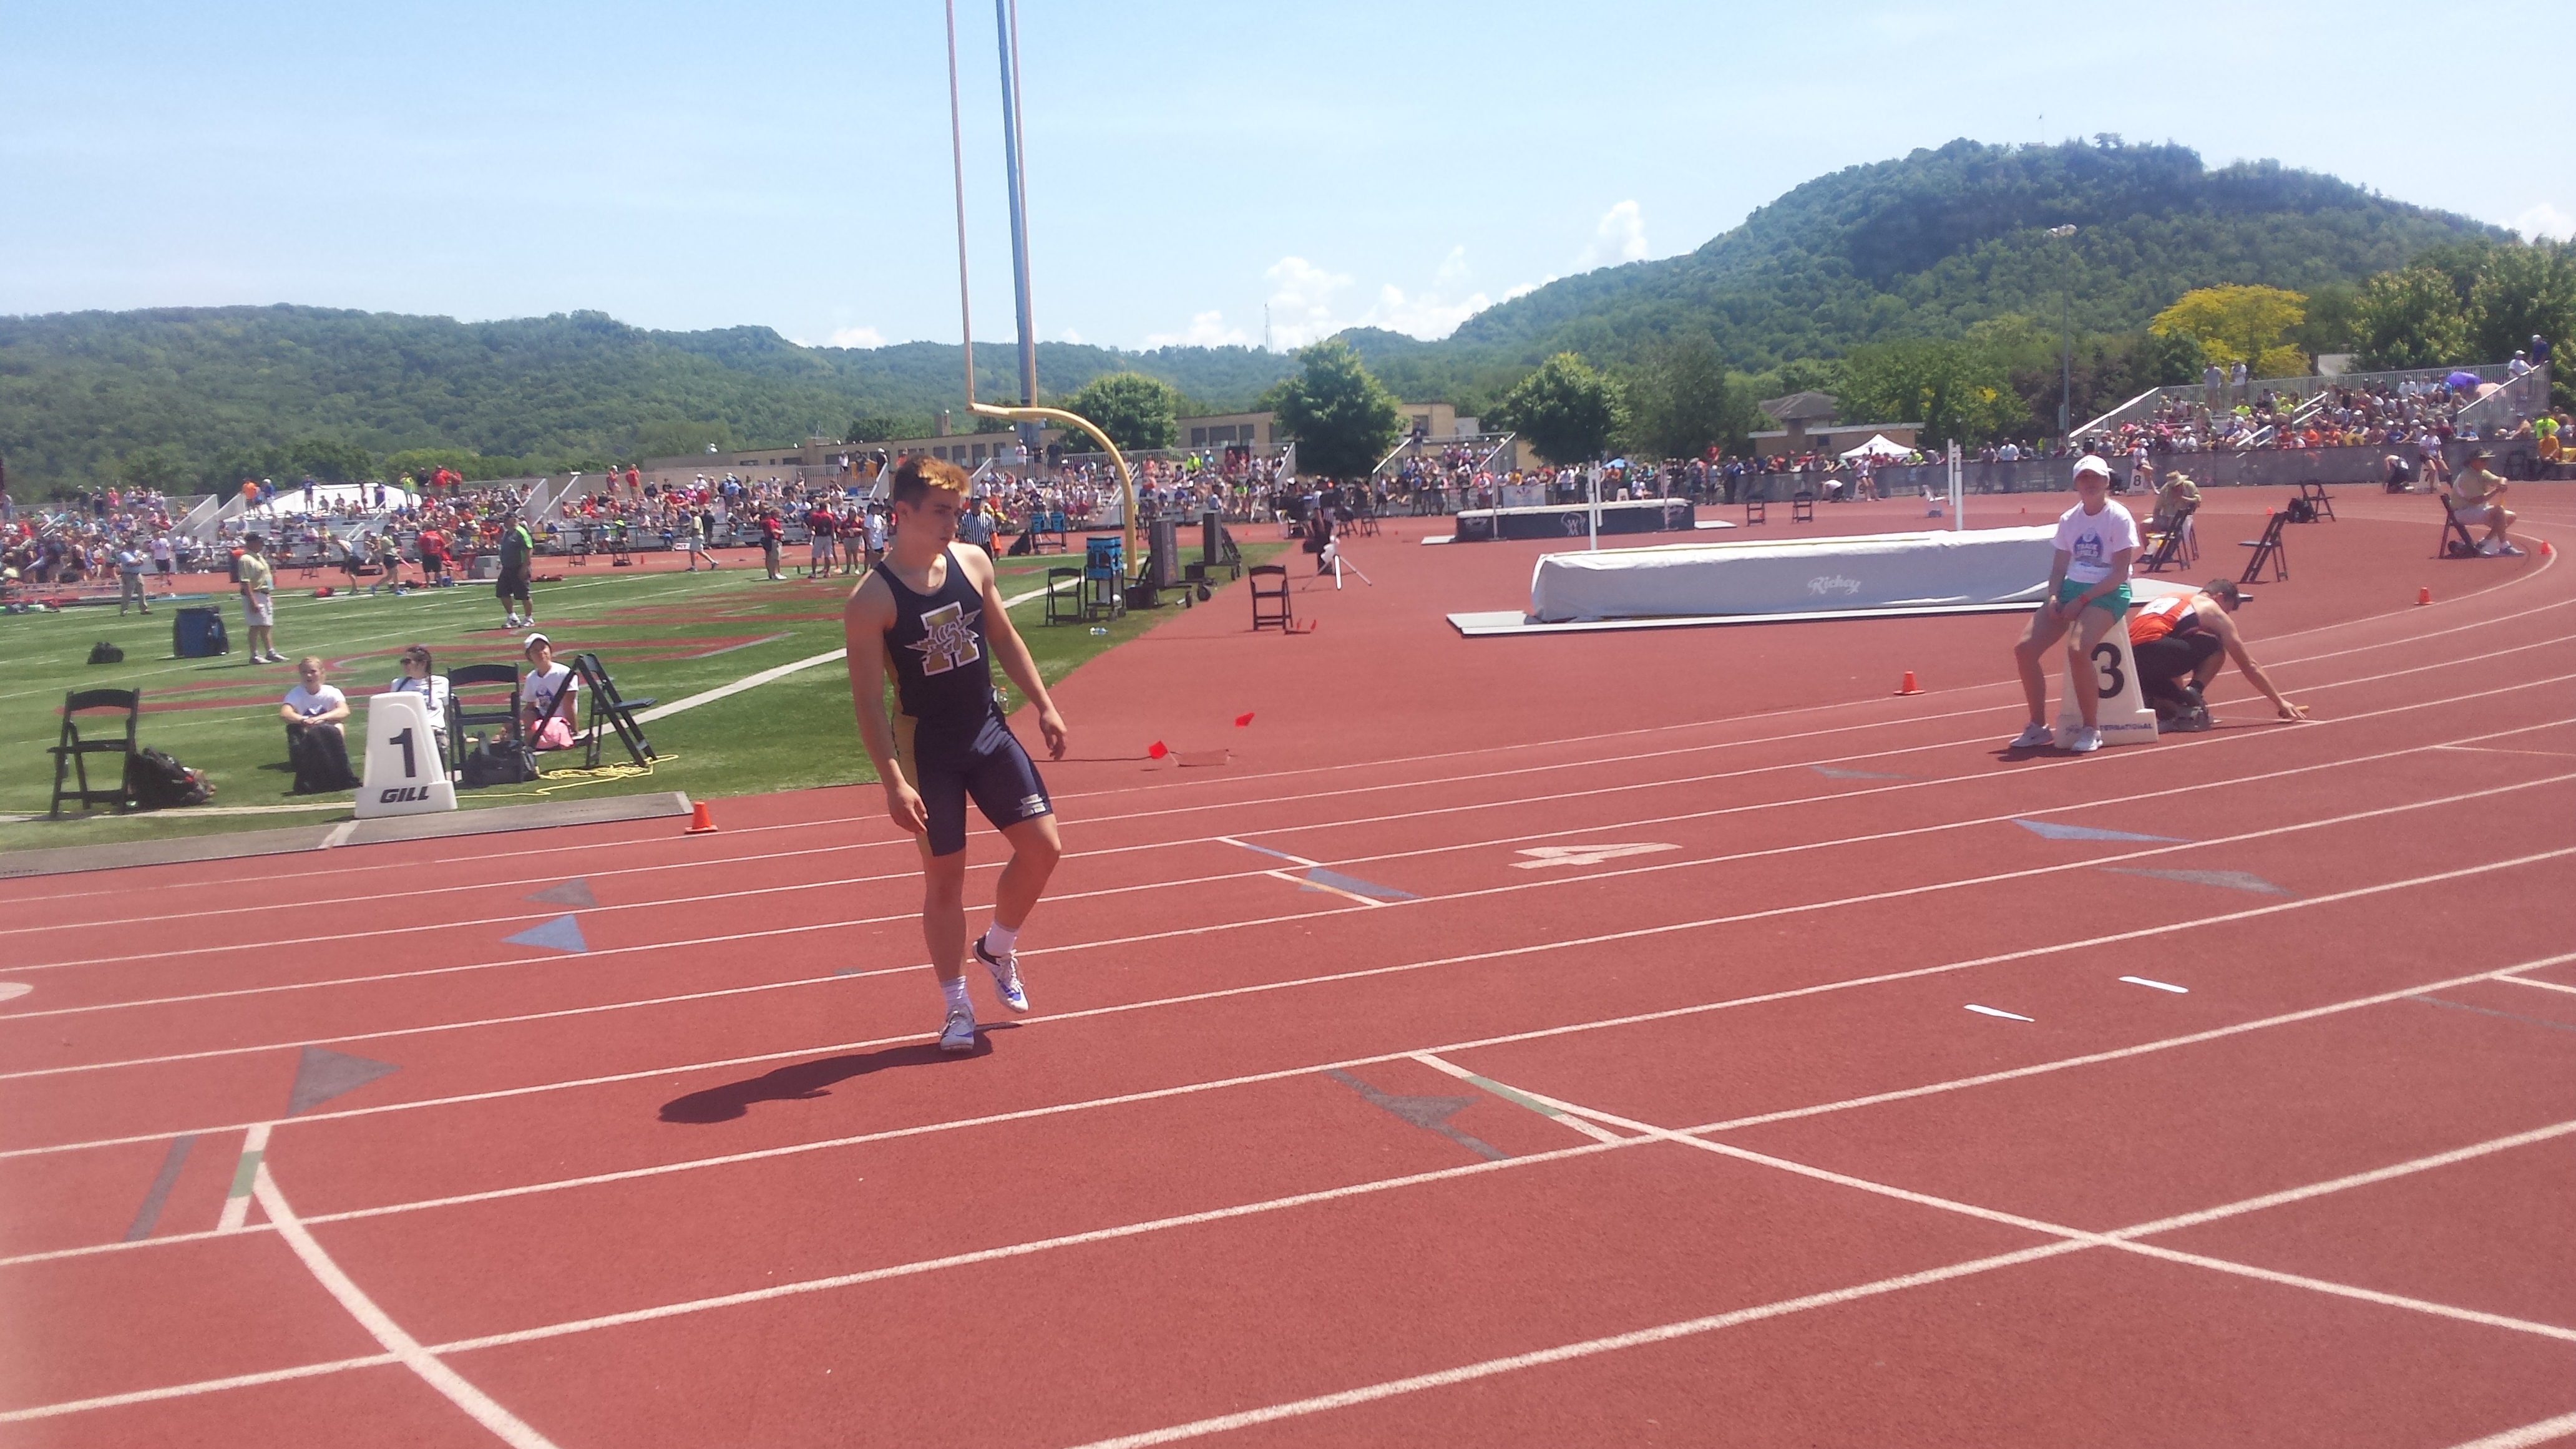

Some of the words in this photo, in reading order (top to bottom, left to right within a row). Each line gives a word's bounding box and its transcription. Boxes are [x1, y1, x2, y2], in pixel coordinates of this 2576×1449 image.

[2133, 475, 2141, 486] 8
[2090, 642, 2125, 699] 3
[389, 728, 416, 778] 1
[379, 786, 429, 803] GILL
